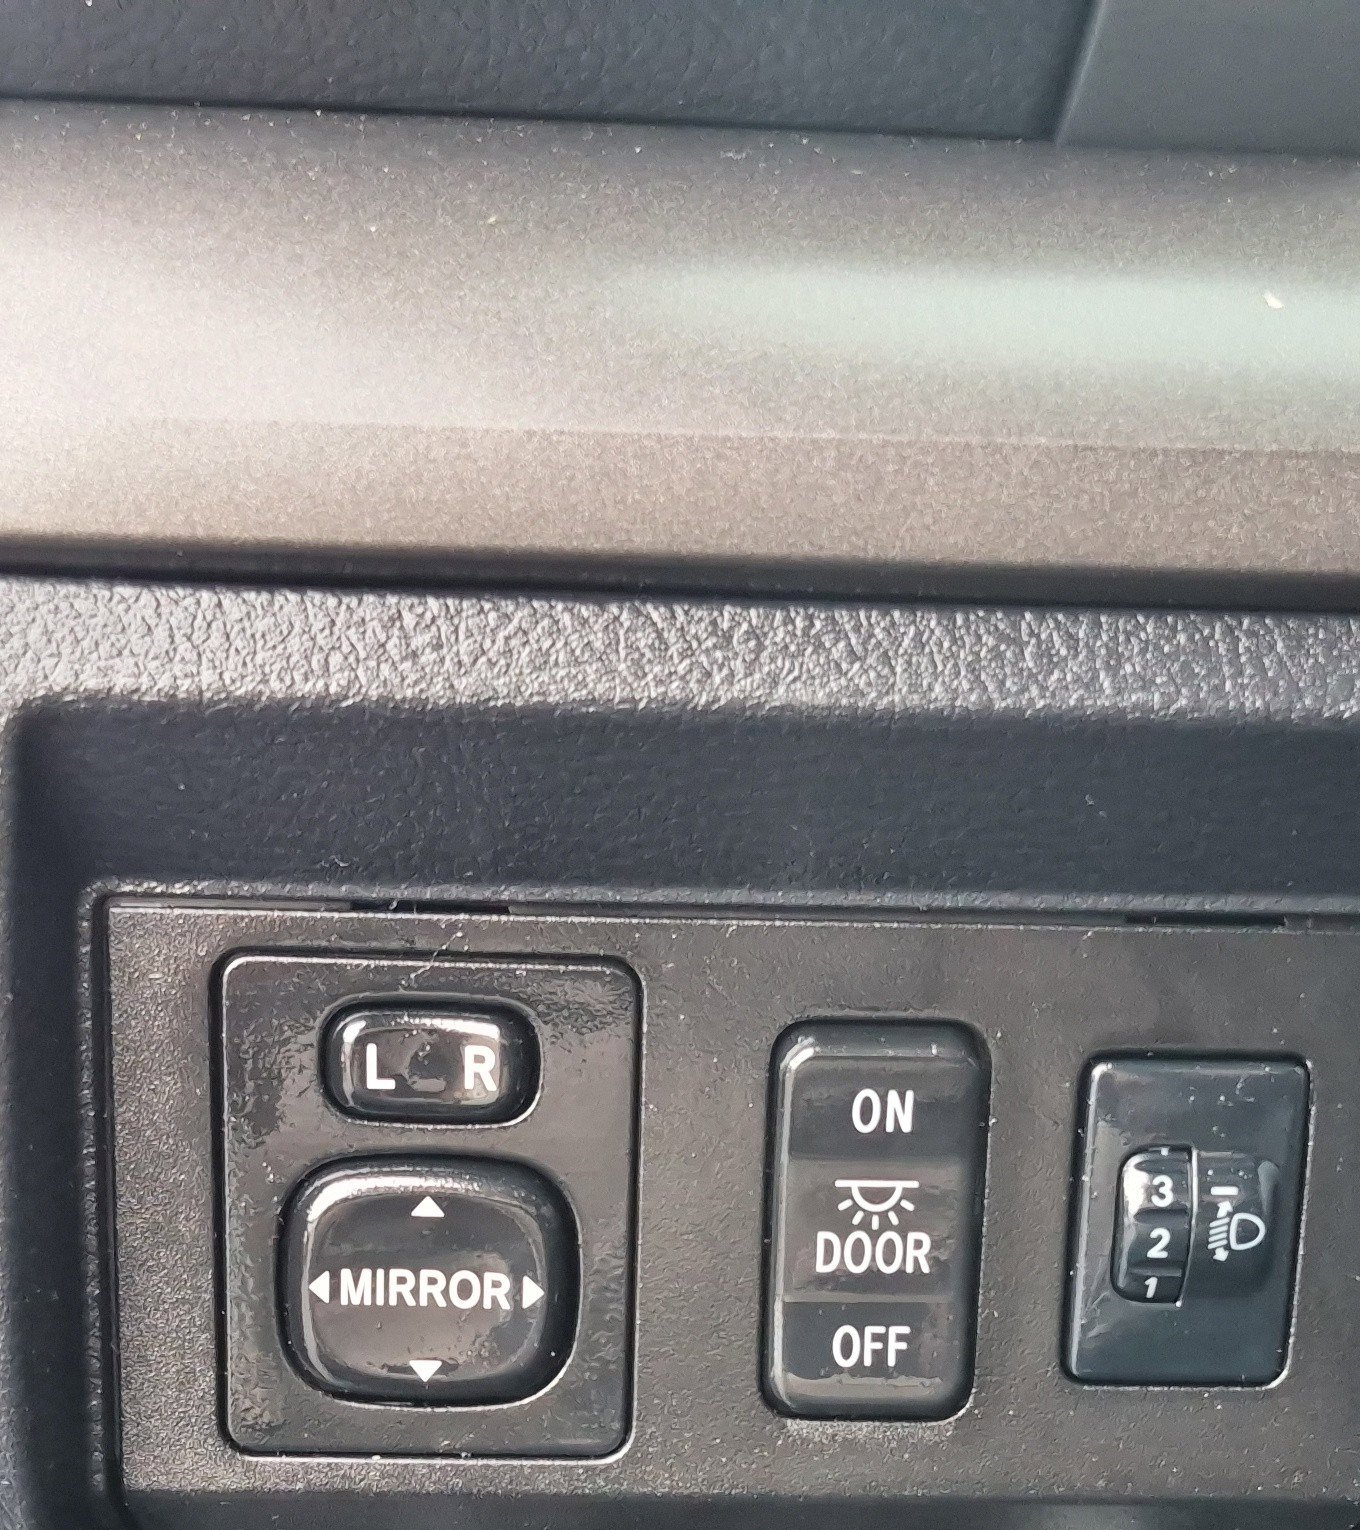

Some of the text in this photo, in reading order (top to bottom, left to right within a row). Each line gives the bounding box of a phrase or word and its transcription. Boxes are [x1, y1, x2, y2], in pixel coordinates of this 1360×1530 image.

[366, 1042, 497, 1091] L R
[851, 1088, 915, 1134] ON
[1151, 1175, 1173, 1208] 3
[815, 1230, 931, 1275] DOOR
[1146, 1228, 1170, 1259] 2
[339, 1268, 512, 1310] MIRROR
[1143, 1277, 1158, 1299] 1
[832, 1325, 911, 1368] OFF
